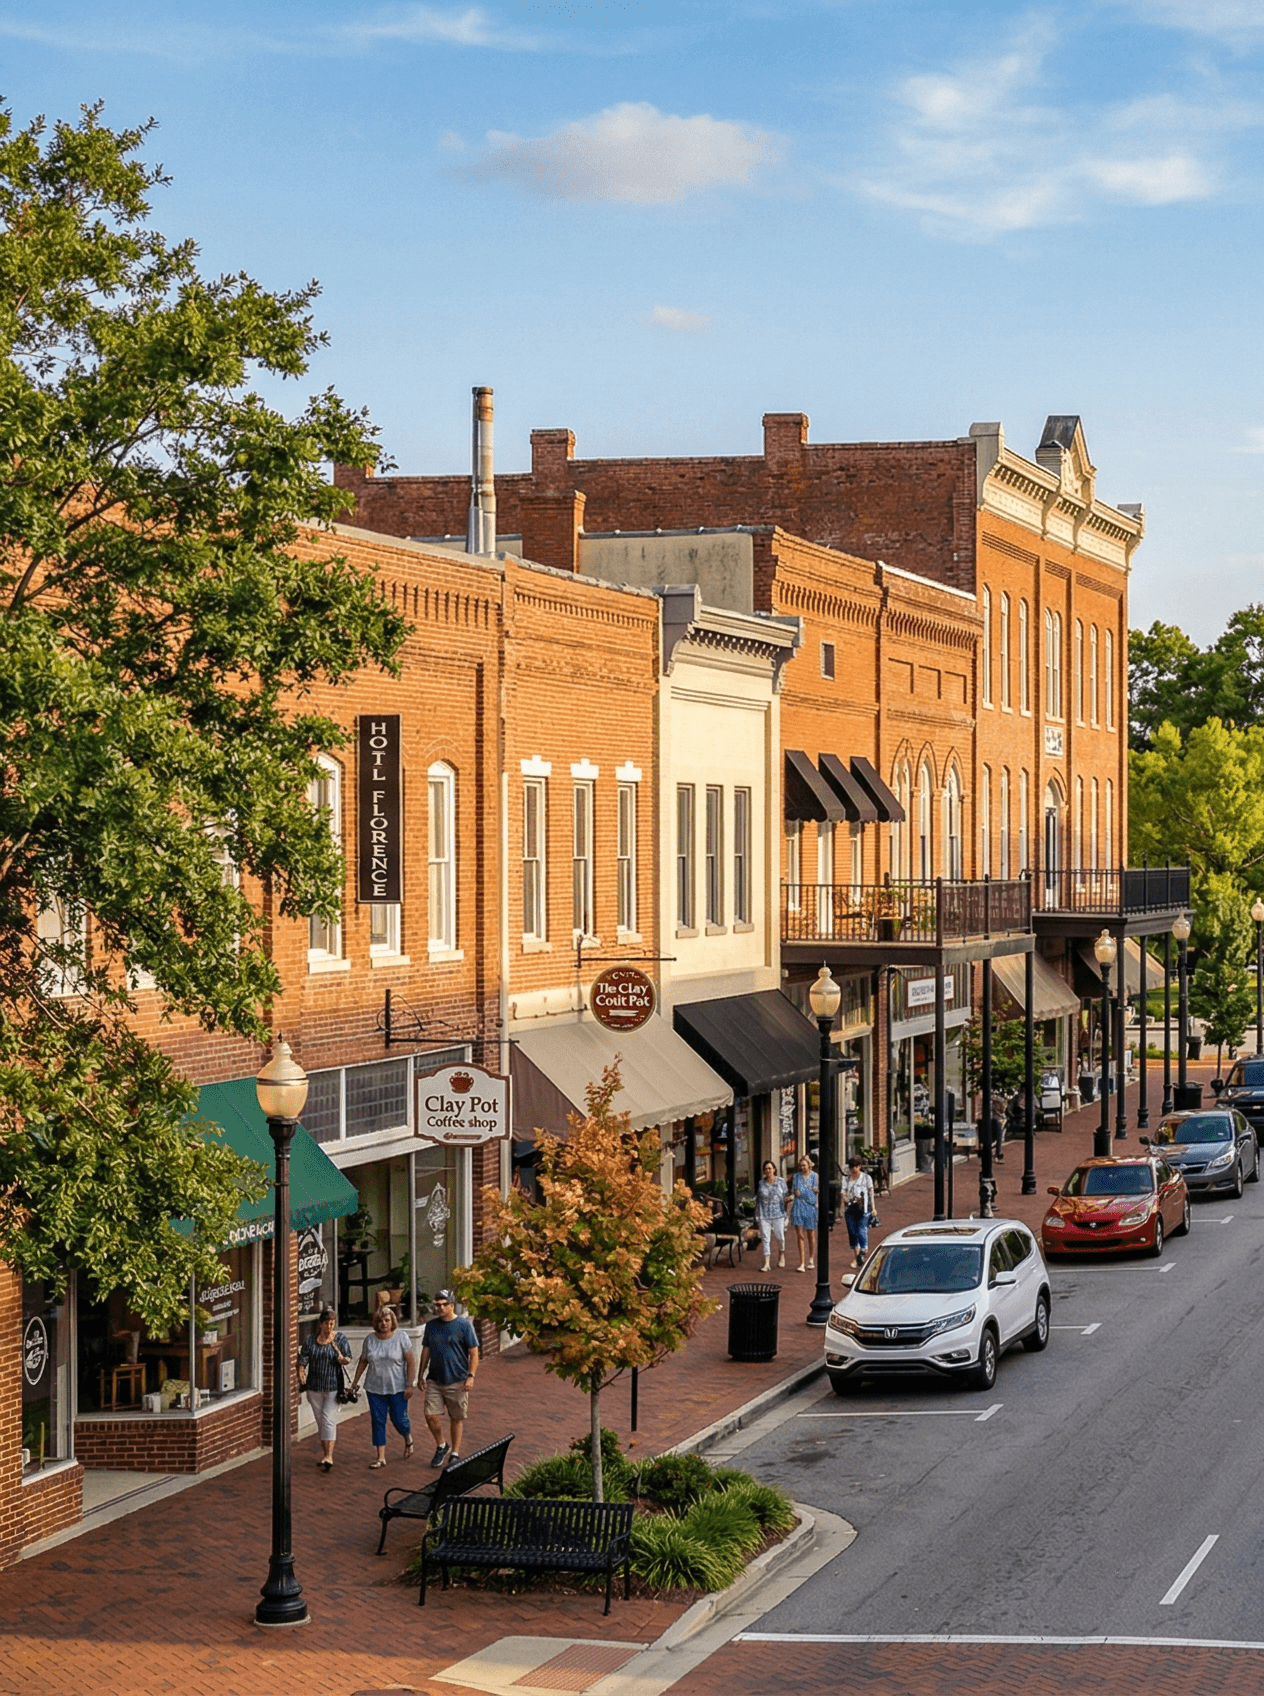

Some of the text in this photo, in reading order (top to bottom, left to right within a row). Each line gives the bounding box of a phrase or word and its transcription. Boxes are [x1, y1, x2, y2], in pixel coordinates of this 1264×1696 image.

[369, 722, 389, 897] HOTL FLORENCE
[618, 982, 649, 997] Clay
[425, 1095, 499, 1118] Clay Pot
